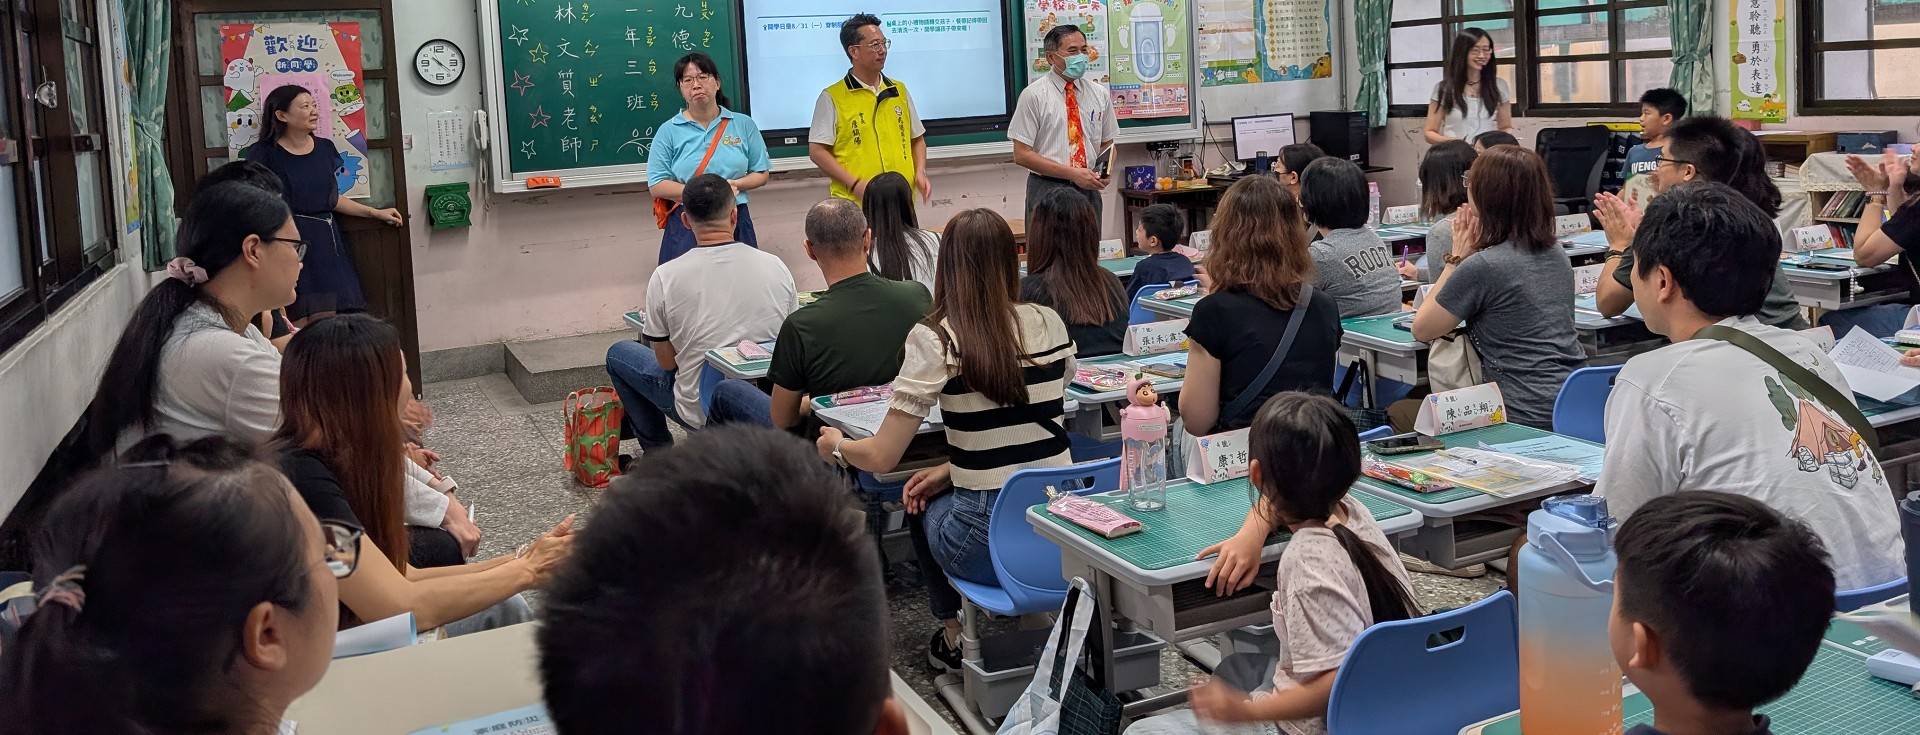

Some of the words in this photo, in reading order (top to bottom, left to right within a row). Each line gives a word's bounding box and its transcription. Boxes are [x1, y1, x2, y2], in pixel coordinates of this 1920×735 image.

[1038, 0, 1102, 12] 學校的一天
[672, 3, 697, 51] 九德
[264, 34, 318, 55] 歡迎
[433, 45, 444, 53] 12
[276, 60, 313, 70] 新同學
[421, 59, 430, 67] 9
[449, 59, 458, 67] 3
[625, 8, 647, 111] 一年三班
[1750, 41, 1762, 94] 勇於表達
[436, 73, 445, 81] 6
[554, 2, 582, 162] 林文質老師
[1343, 246, 1396, 280] ROOT
[1218, 450, 1247, 468] 康哲
